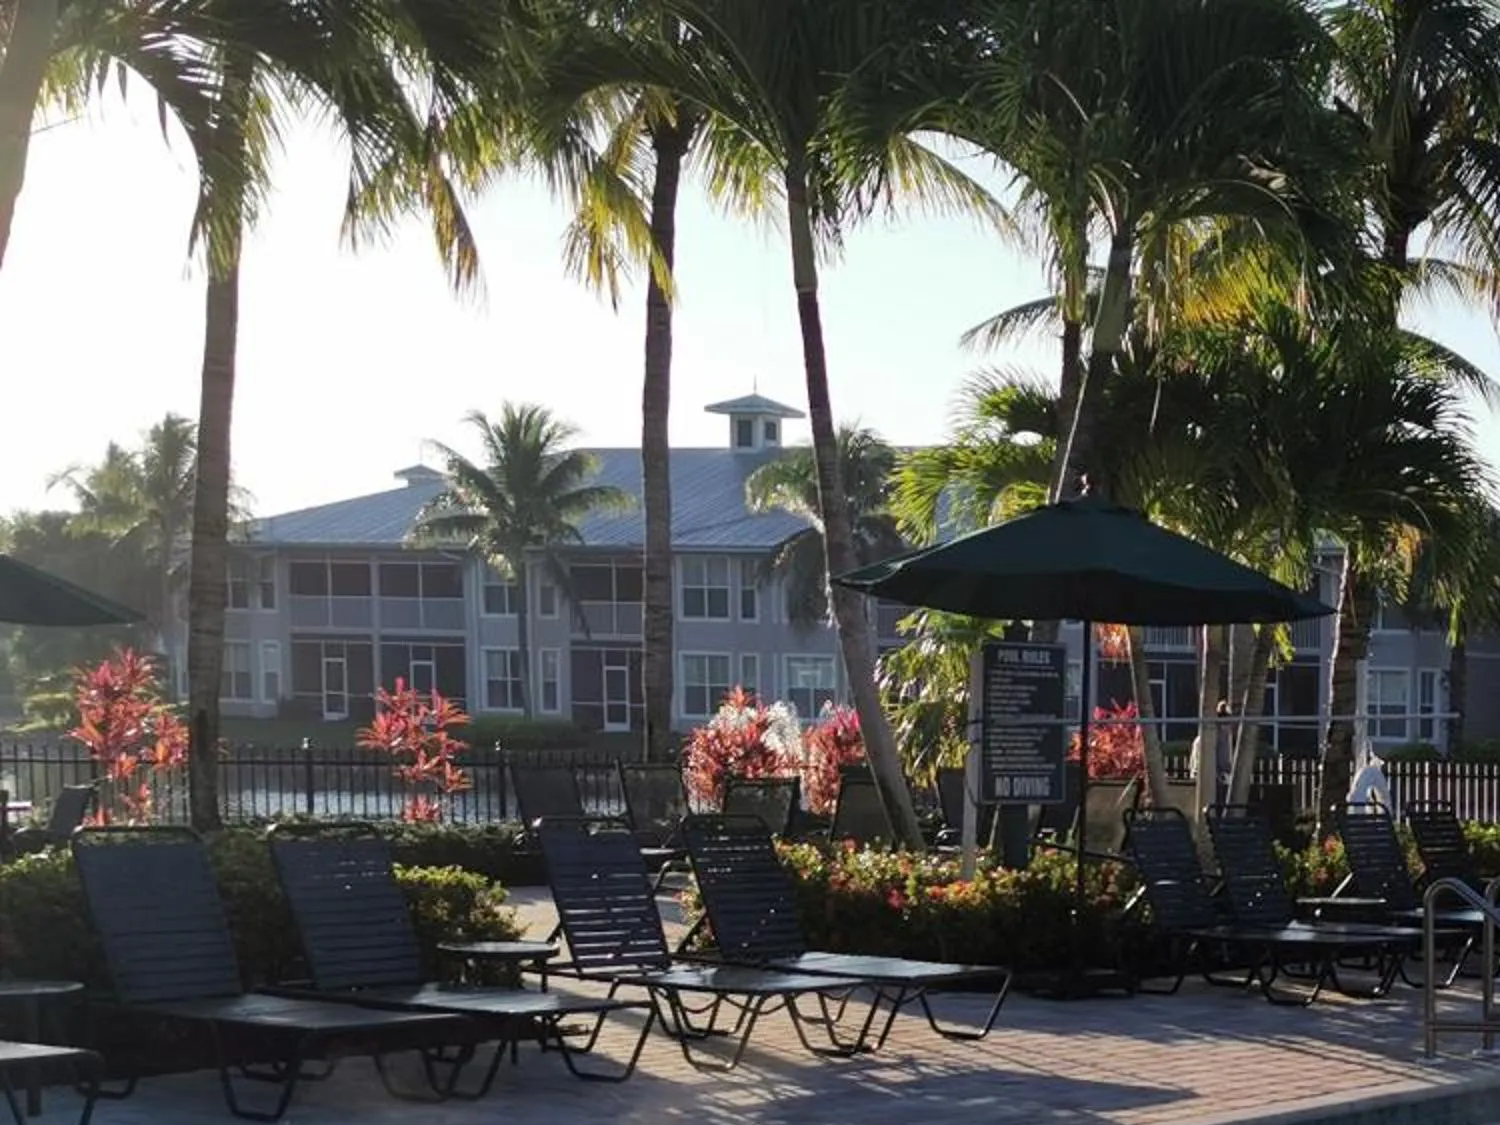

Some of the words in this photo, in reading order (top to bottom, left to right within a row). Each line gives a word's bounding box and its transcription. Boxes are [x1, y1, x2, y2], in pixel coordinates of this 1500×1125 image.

[1022, 650, 1051, 664] RULES
[995, 776, 1011, 797] NO
[1013, 776, 1050, 798] DIVING
